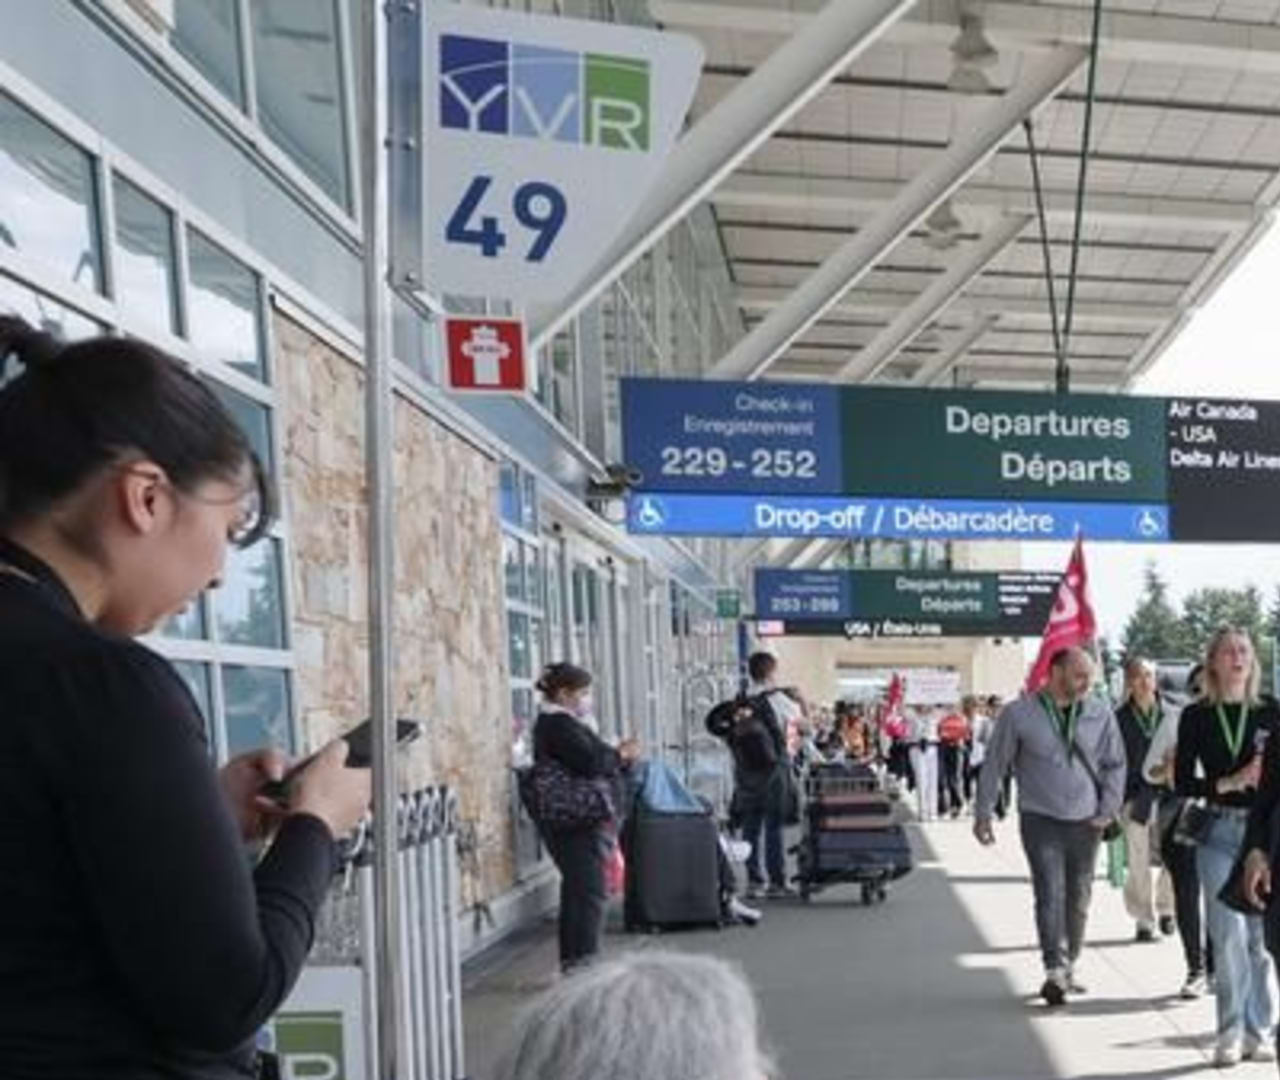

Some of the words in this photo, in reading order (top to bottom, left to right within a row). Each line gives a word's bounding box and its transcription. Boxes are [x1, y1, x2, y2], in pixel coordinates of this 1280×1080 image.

[440, 72, 646, 152] YVR
[445, 175, 568, 263] 49
[735, 393, 814, 413] Check-in
[1169, 402, 1192, 418] Air
[1197, 403, 1258, 421] Canada
[684, 415, 815, 438] Enregistrement
[946, 405, 1131, 440] Departures
[1182, 426, 1217, 442] USA
[1000, 450, 1132, 486] Départs
[1170, 449, 1214, 467] Delta
[1218, 450, 1240, 467] Air
[755, 504, 863, 534] Drop-off
[895, 505, 1054, 534] Débarcadère
